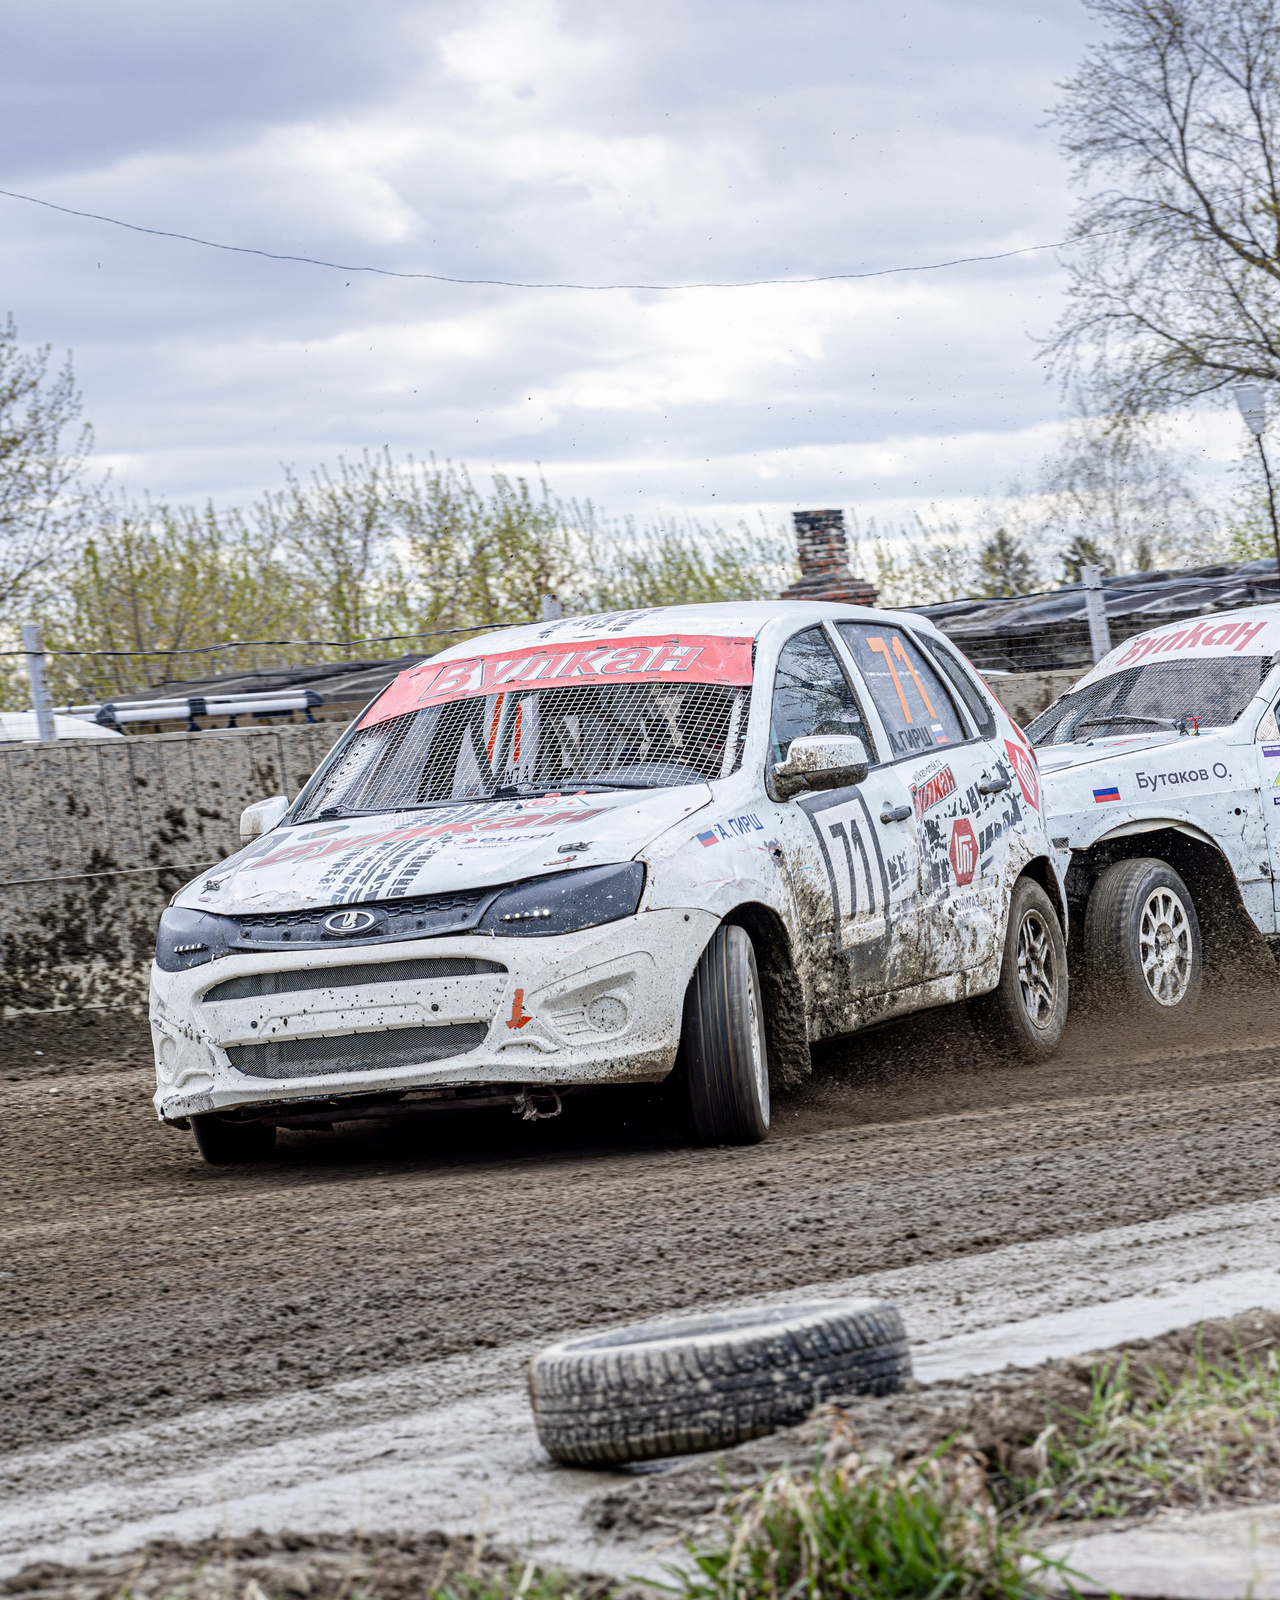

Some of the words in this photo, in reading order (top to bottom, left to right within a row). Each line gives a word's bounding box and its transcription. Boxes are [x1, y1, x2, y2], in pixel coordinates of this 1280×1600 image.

[418, 645, 707, 701] Вулкан
[1115, 622, 1269, 667] Вулкан
[865, 636, 938, 724] 71
[1135, 768, 1210, 792] Бутаков
[1212, 762, 1233, 779] О.
[240, 806, 617, 872] Вулкан
[828, 819, 875, 920] 71
